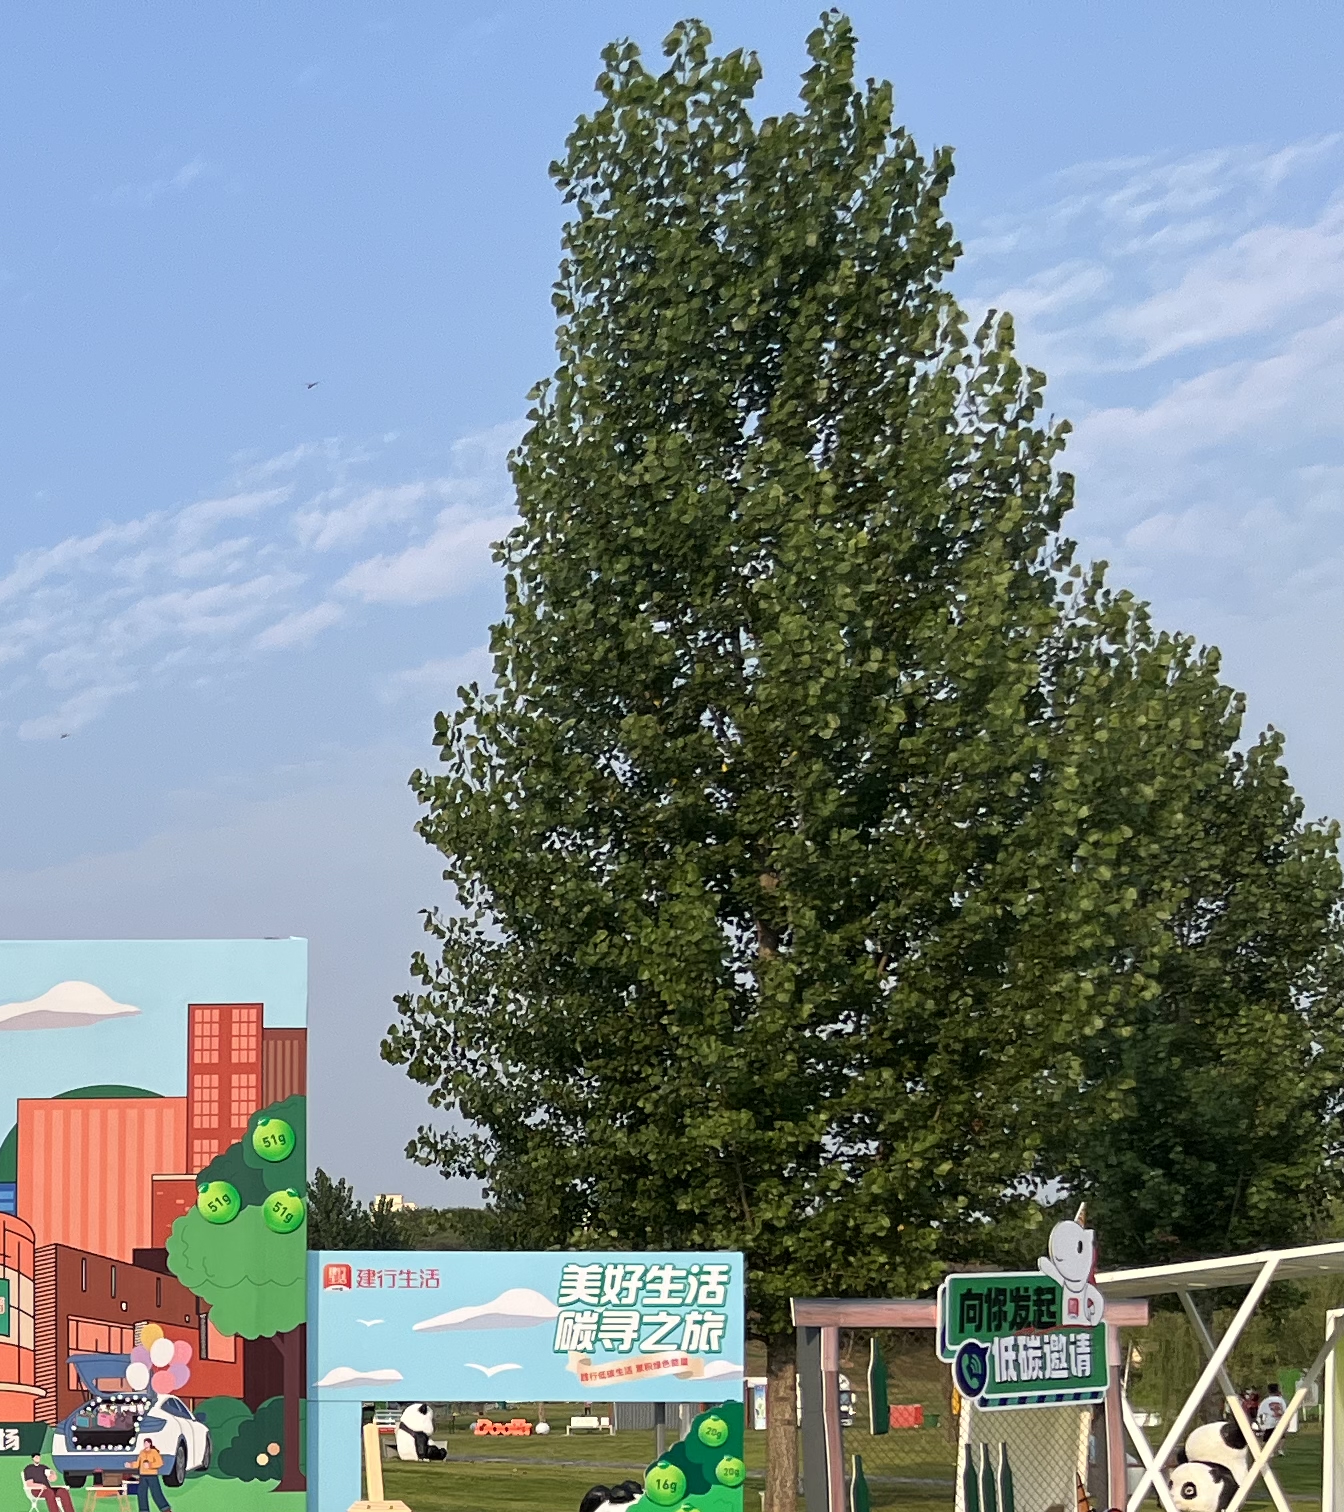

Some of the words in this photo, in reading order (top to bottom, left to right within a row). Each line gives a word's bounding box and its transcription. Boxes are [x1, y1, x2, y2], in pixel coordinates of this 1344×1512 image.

[262, 1134, 286, 1148] 51g
[207, 1194, 231, 1212] 51g
[272, 1202, 293, 1224] 51g
[356, 1268, 440, 1289] 建行生活
[558, 1263, 732, 1307] 美好生活
[958, 1286, 1057, 1334] 向你发起
[553, 1310, 728, 1354] 碳寻之旅
[992, 1332, 1093, 1383] 低碳邀请
[723, 1467, 740, 1478] 20g
[655, 1478, 678, 1494] 16g
